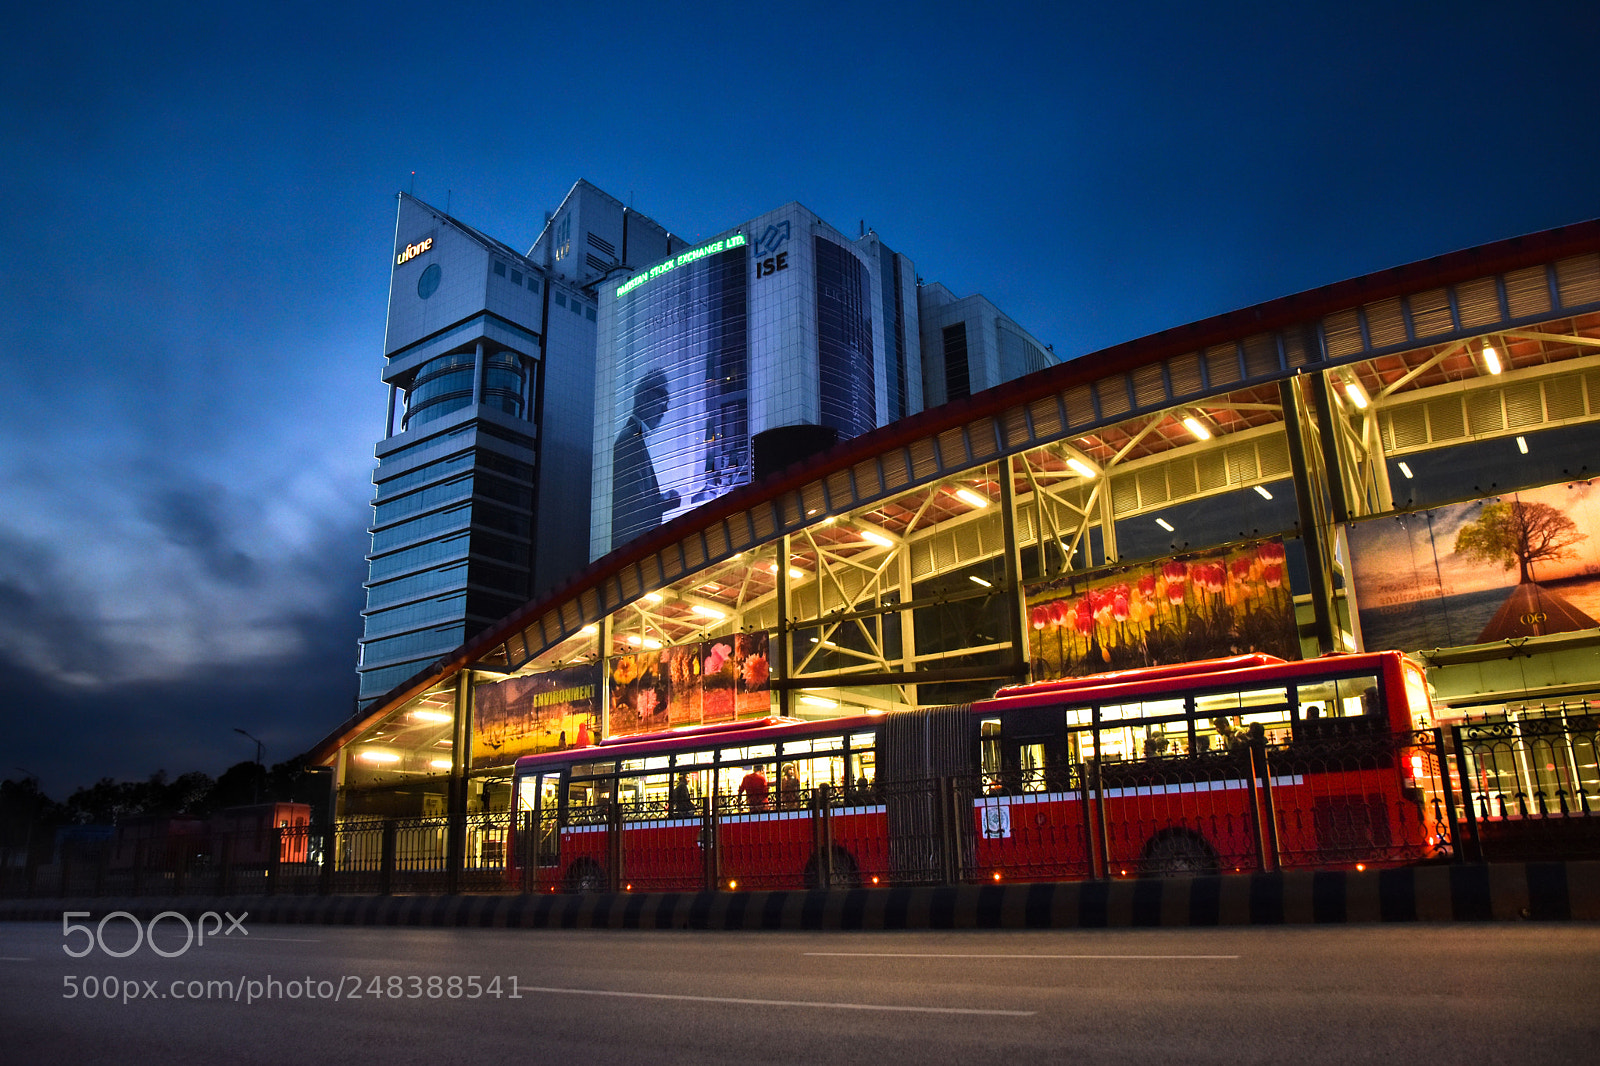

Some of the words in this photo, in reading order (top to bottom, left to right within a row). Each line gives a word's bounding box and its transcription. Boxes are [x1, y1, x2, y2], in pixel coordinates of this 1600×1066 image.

[397, 237, 433, 265] ufone
[756, 251, 788, 279] ISE
[616, 271, 649, 298] PAKISTAN
[649, 258, 675, 278] STOCK
[677, 240, 724, 266] EXCHANGE
[726, 234, 747, 249] LTD.
[533, 684, 596, 708] ENVIRONMENT
